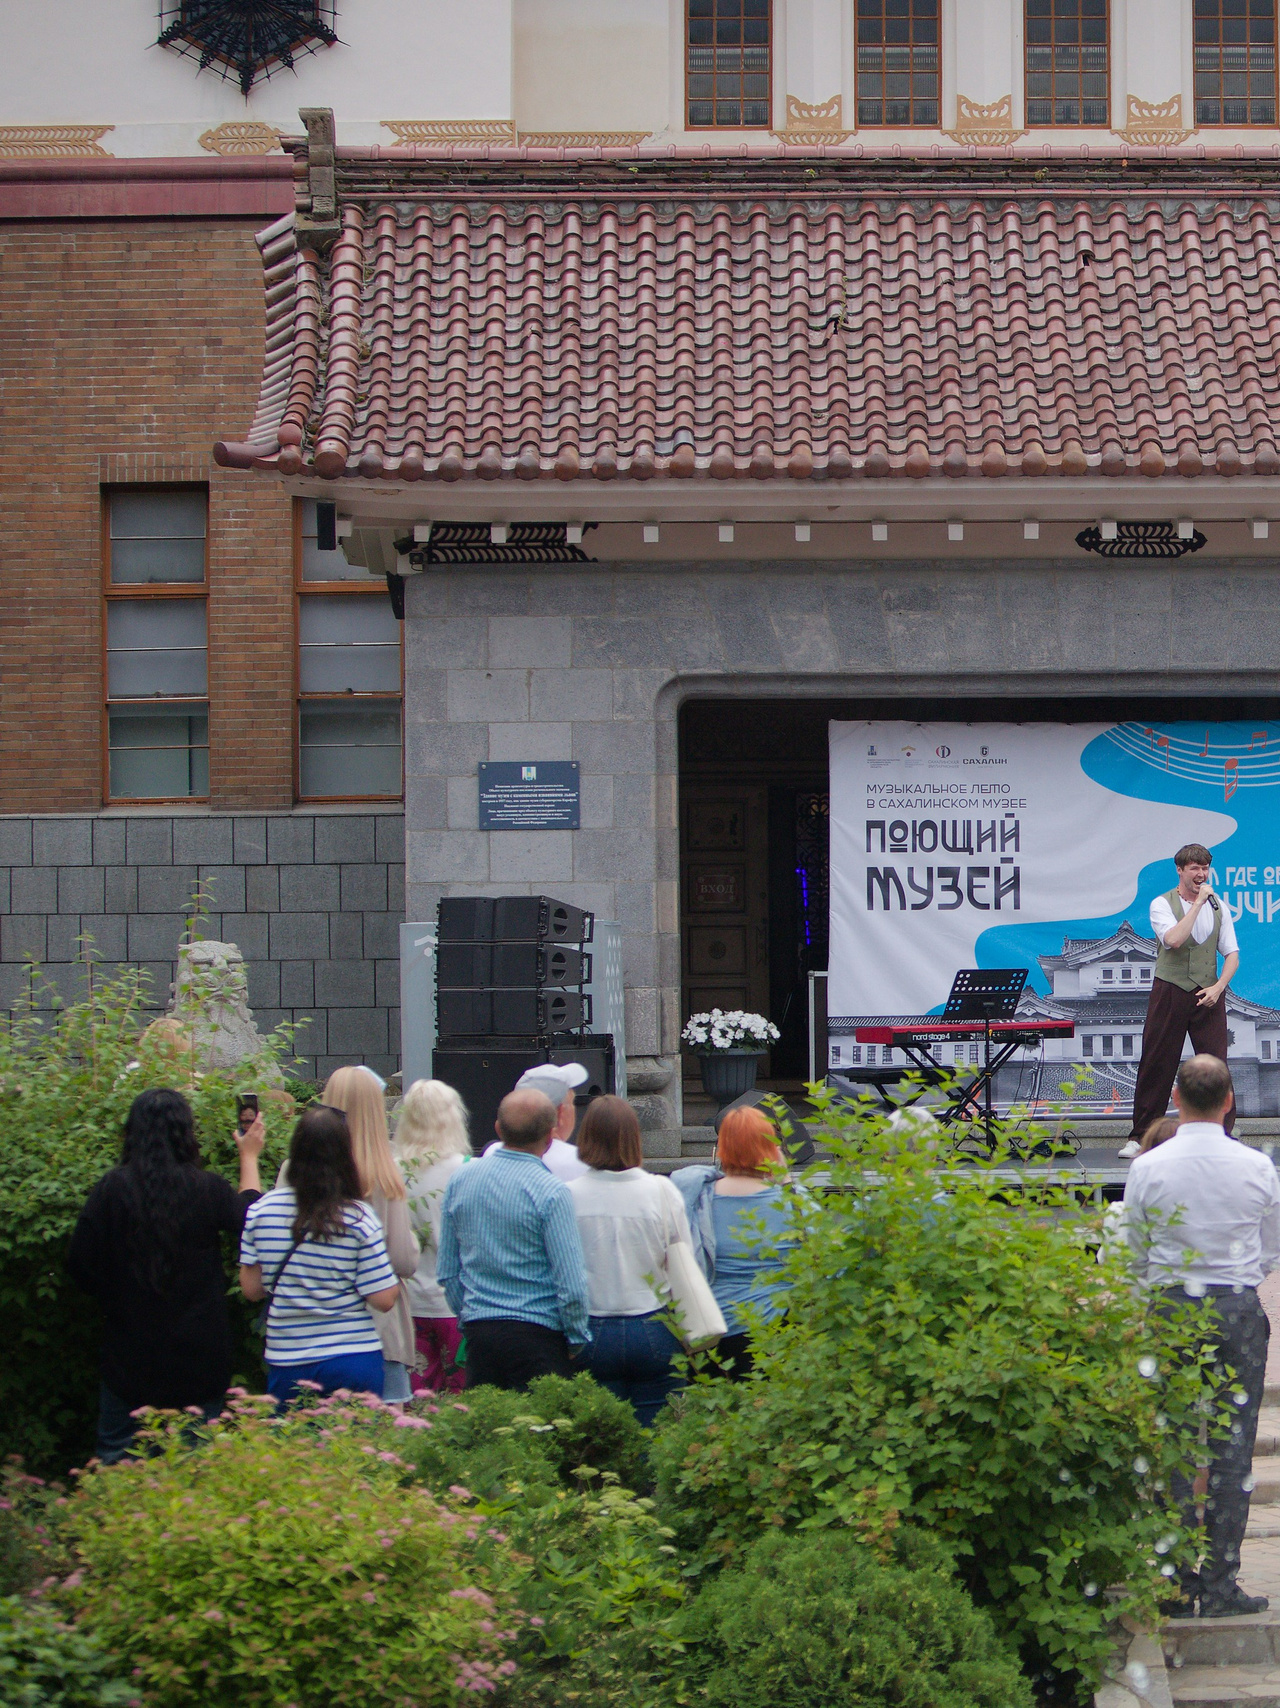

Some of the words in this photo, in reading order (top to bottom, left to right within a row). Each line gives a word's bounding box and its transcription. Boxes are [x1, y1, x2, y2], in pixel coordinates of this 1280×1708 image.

[866, 783, 967, 794] МУЗЫКАЛЬНОЕ
[970, 783, 1011, 794] ЛЕТО
[866, 798, 875, 808] В
[878, 798, 979, 809] САХАЛИНСКОМ
[982, 798, 1027, 809] МУЗЕЕ
[866, 813, 1020, 855] ПОЮЩИЙ
[1226, 866, 1257, 887] ГДЕ
[700, 884, 734, 894] ВХОД
[866, 857, 1021, 911] МУЗЕЙ
[912, 1033, 928, 1041] nord
[928, 1033, 945, 1041] stage
